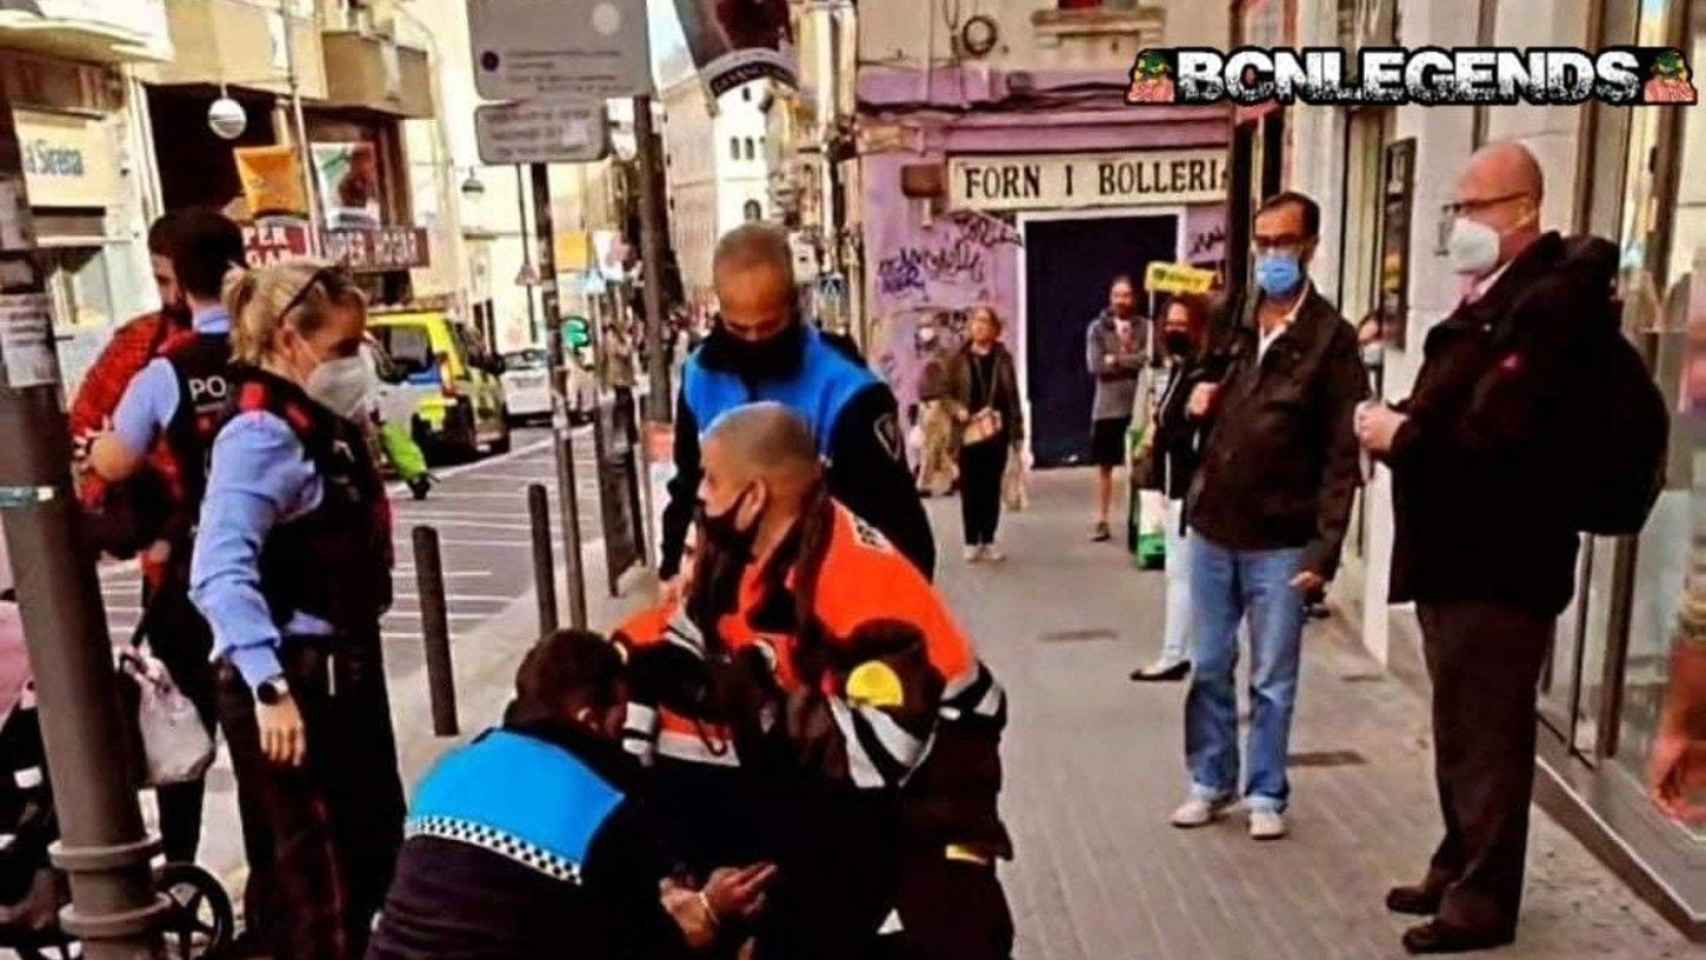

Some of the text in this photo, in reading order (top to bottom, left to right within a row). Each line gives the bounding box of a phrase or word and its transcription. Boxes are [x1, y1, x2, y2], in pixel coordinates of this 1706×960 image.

[965, 158, 1229, 199] FORN I BOLLERI
[243, 226, 288, 247] PER
[189, 375, 227, 401] PO
